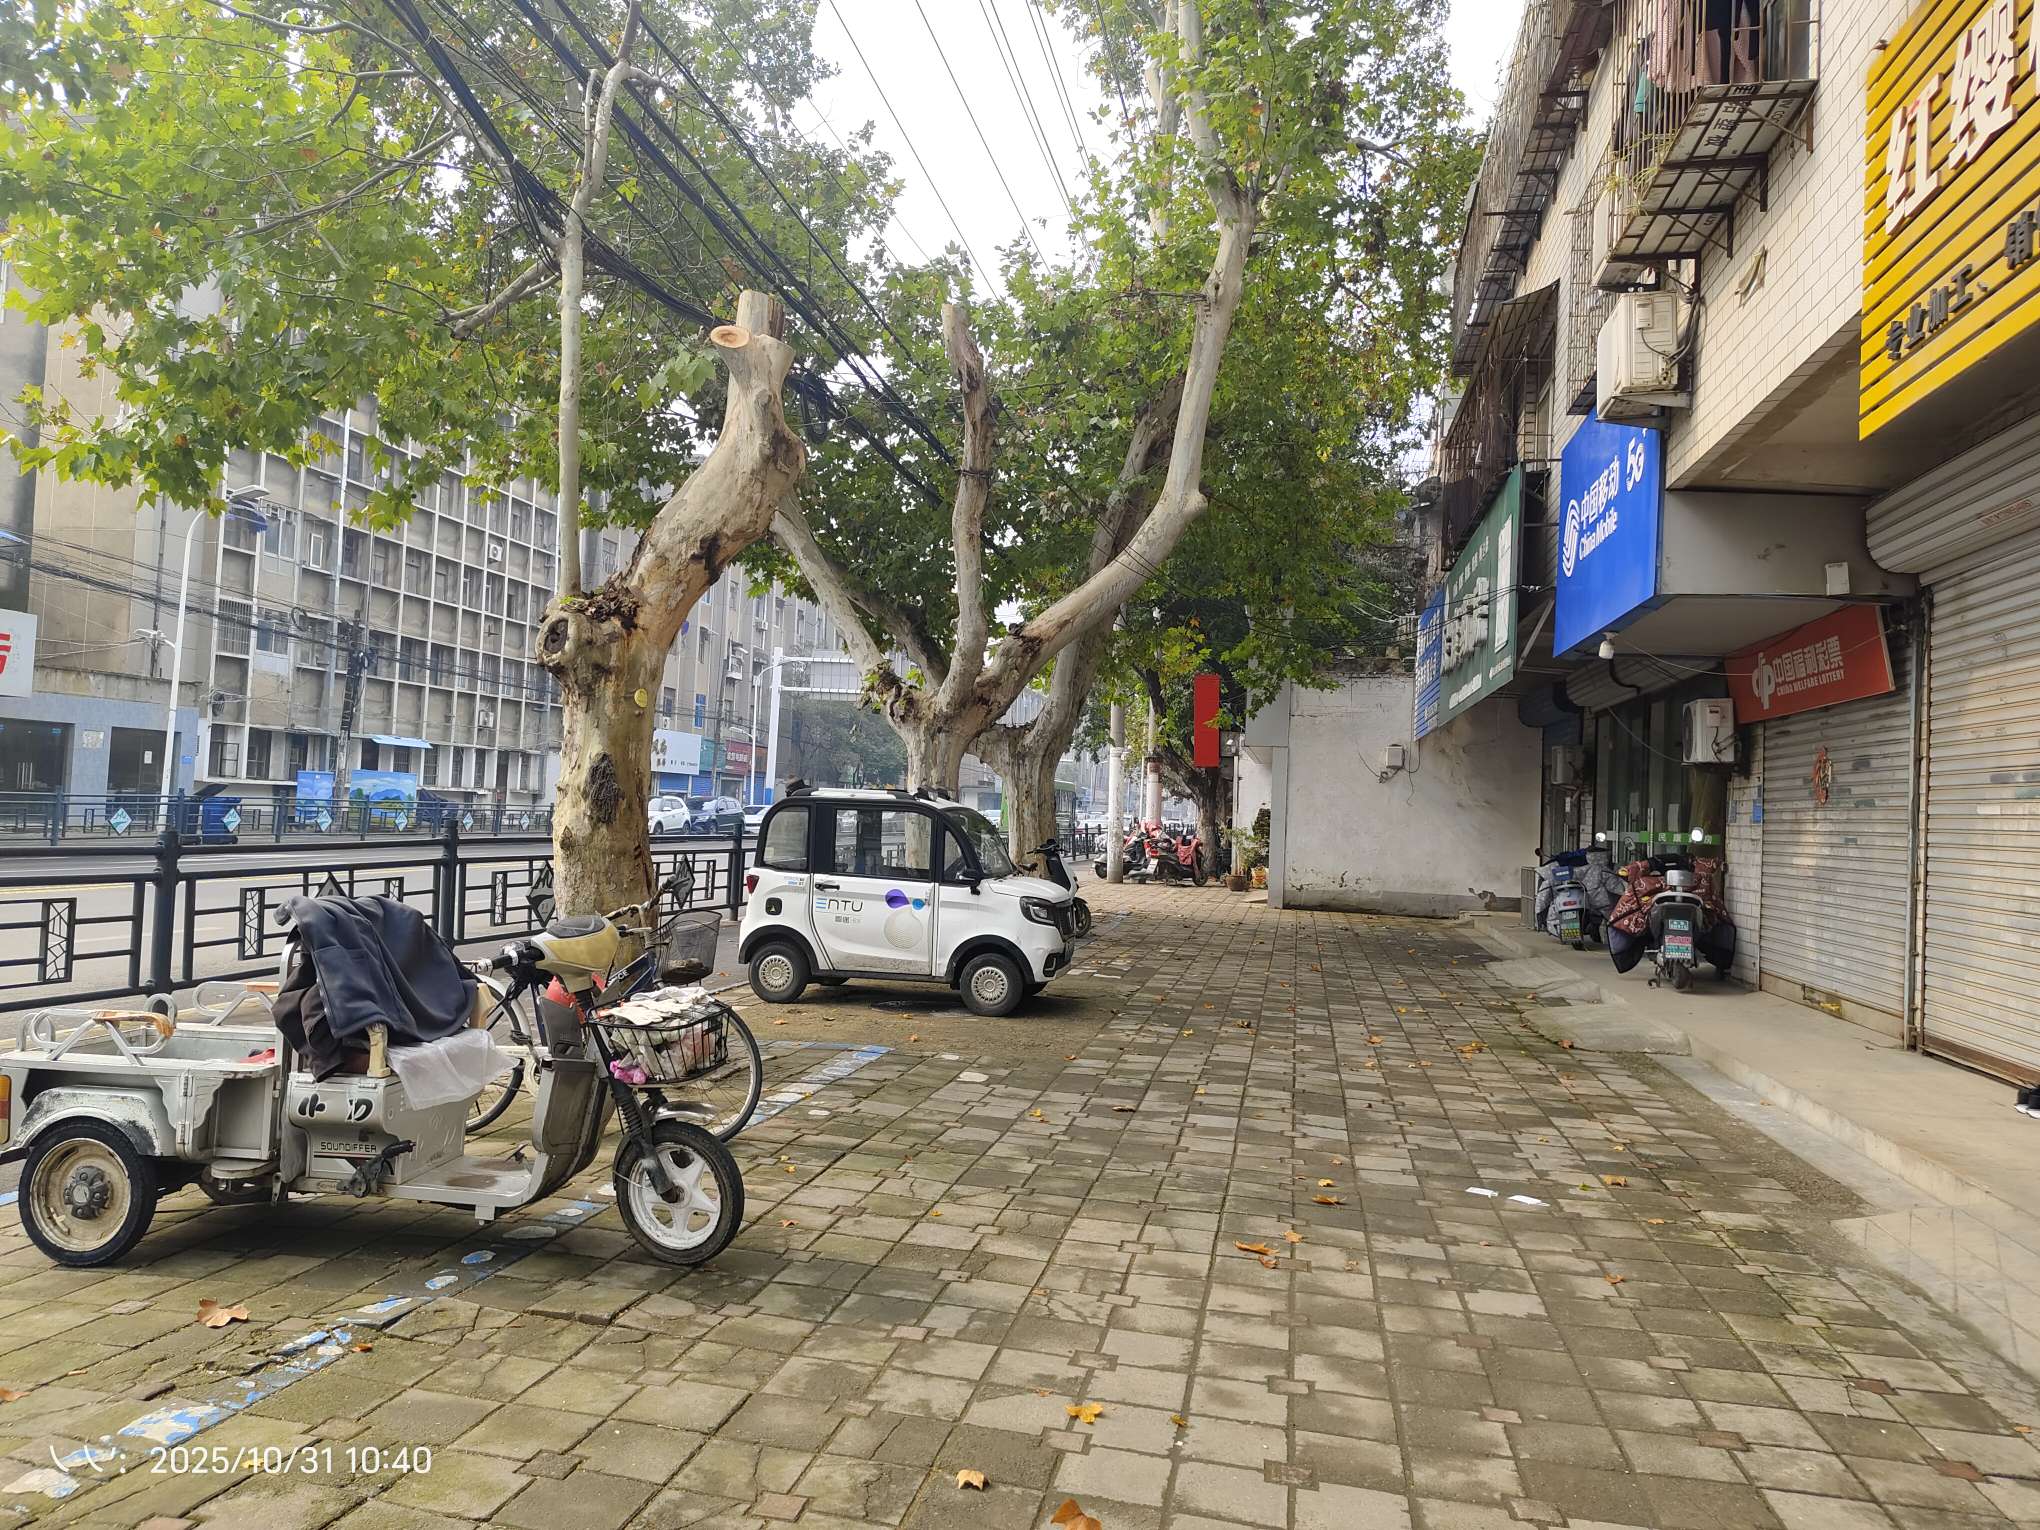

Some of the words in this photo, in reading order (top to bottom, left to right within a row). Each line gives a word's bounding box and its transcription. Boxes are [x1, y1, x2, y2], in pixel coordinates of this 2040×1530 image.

[1580, 455, 1620, 530] 中国移动
[1579, 531, 1596, 561] China
[1596, 507, 1618, 547] Mobile
[1772, 635, 1844, 684] 中国福利彩票
[1776, 683, 1794, 697] CHINA
[1793, 675, 1819, 692] WELFARE
[1819, 669, 1845, 685] LOTTERY
